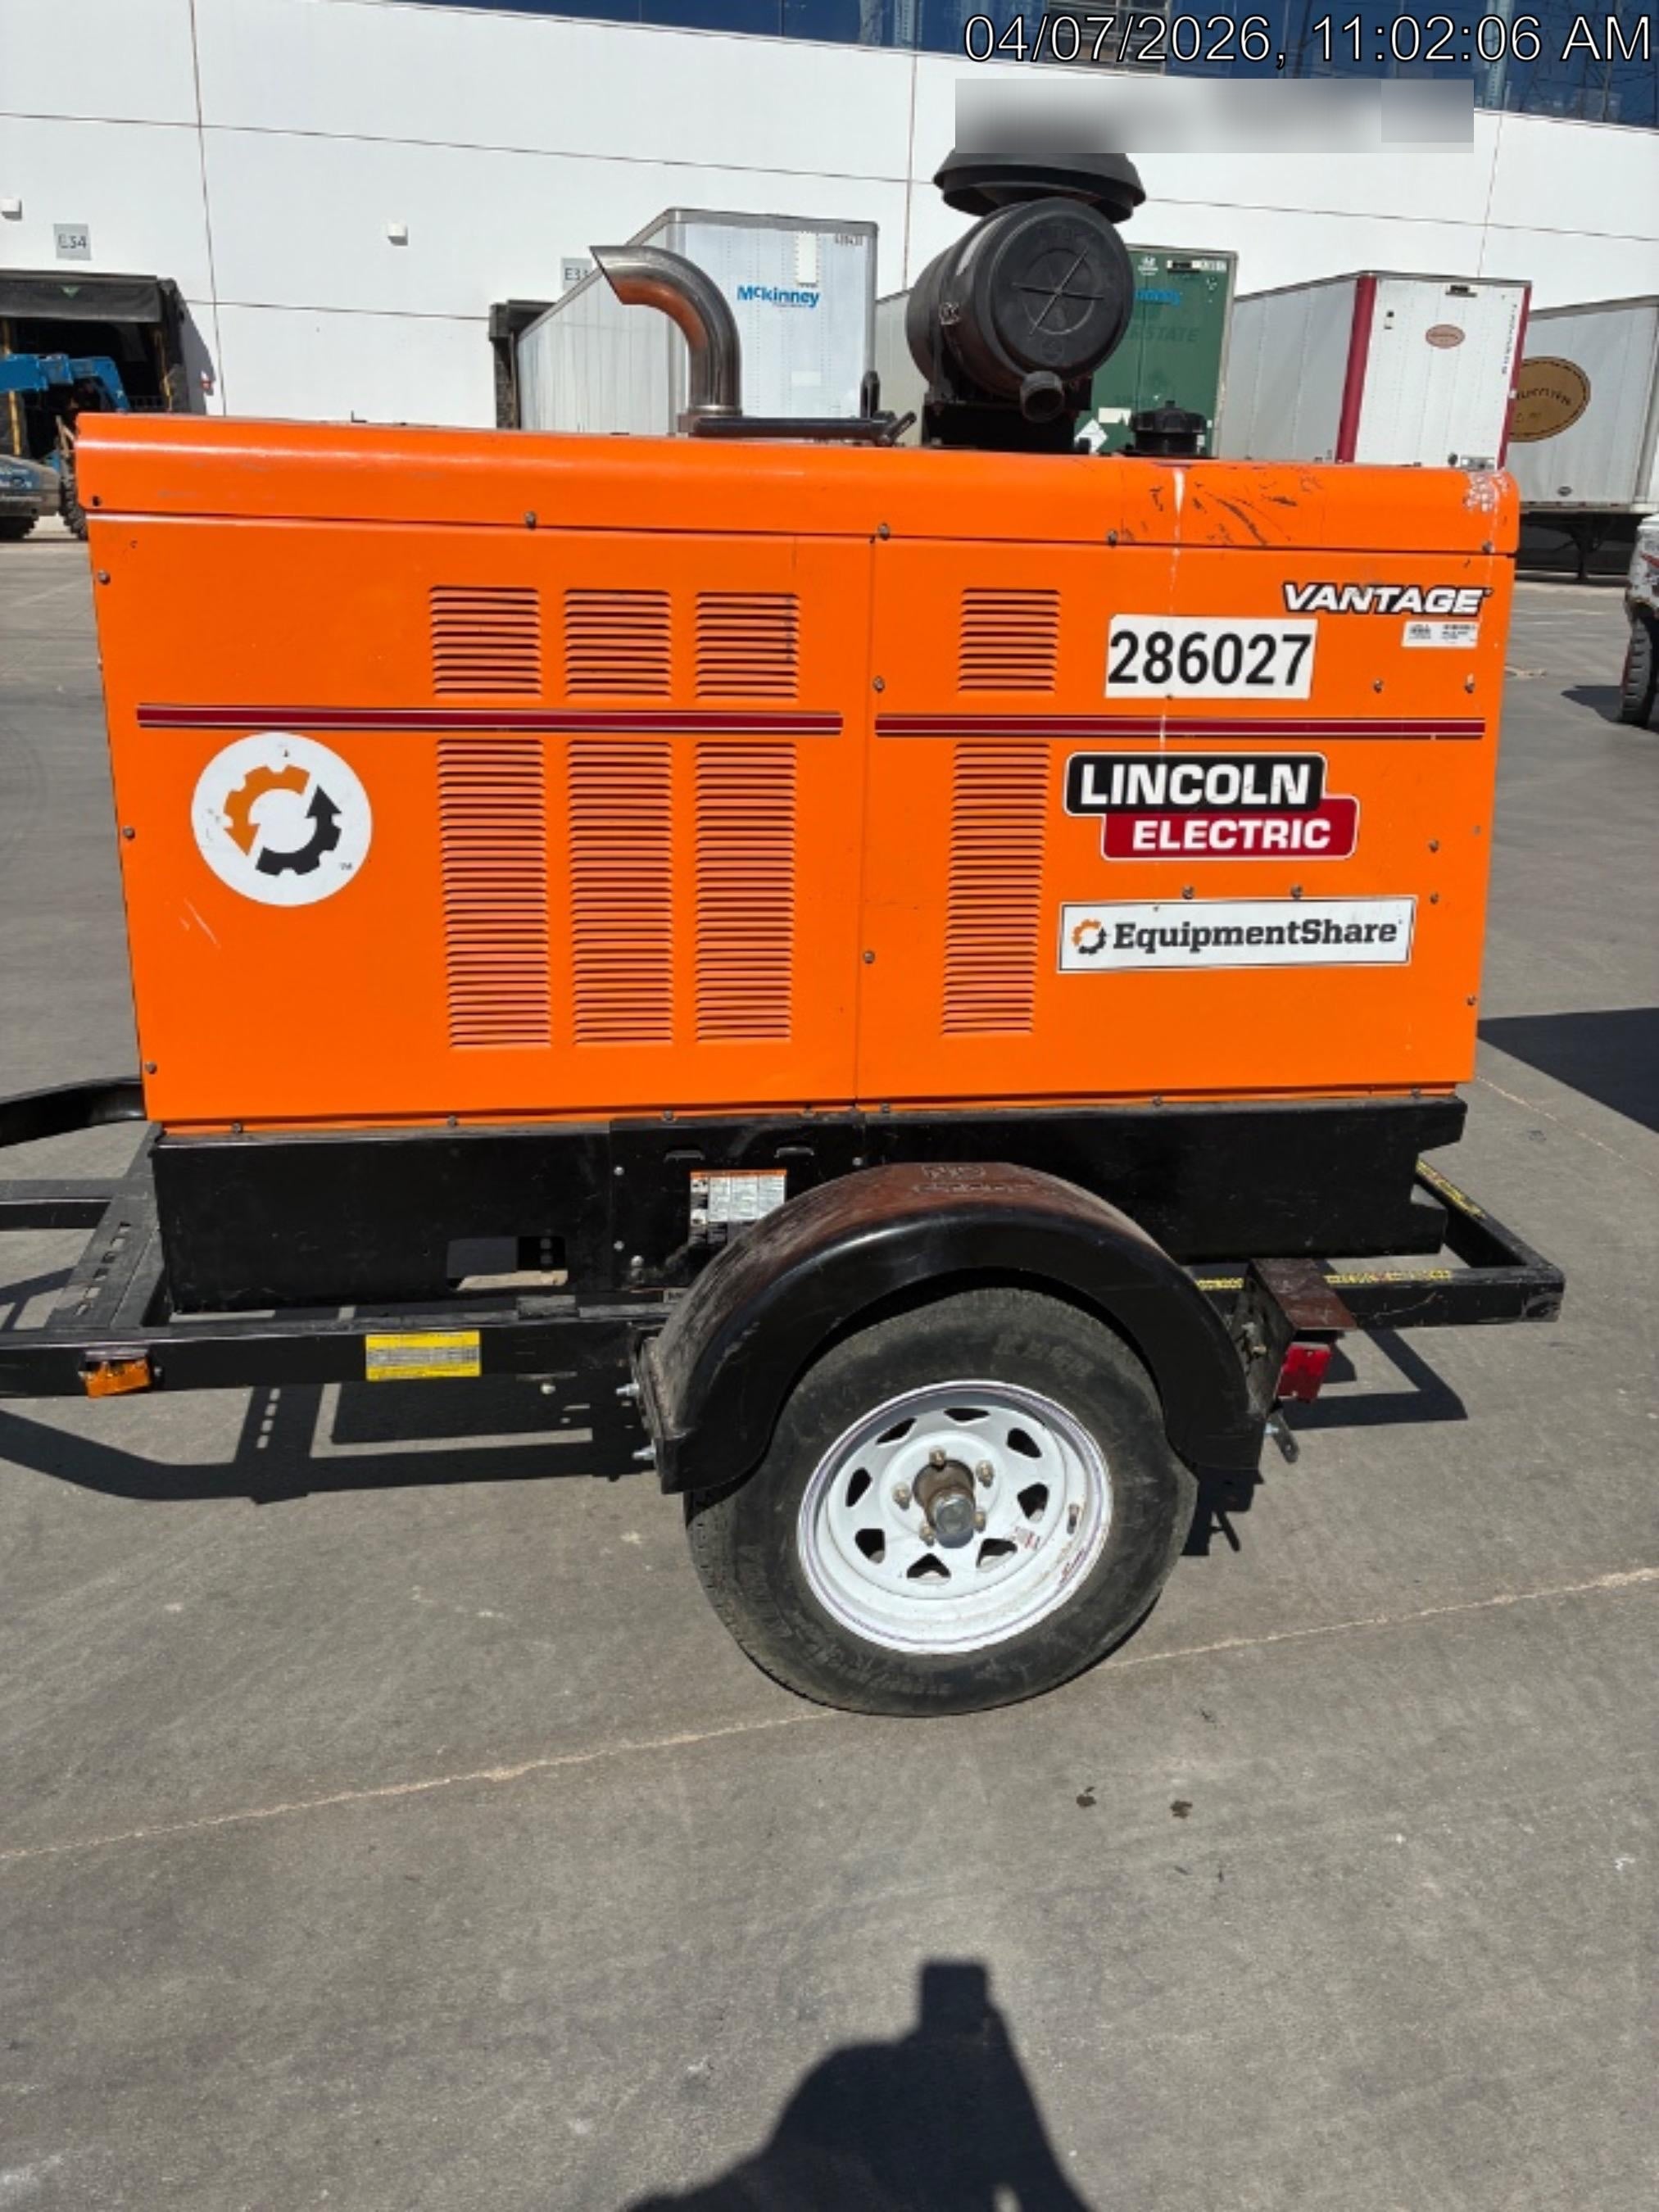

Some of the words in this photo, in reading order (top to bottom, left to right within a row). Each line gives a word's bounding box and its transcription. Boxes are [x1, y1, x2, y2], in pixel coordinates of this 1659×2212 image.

[1283, 582, 1485, 614] VANTAGE
[1108, 631, 1312, 686] 286027
[1080, 763, 1311, 805] LINCOLN
[1132, 819, 1331, 850] ELECTRIC
[1113, 918, 1398, 954] EquipmentShare
